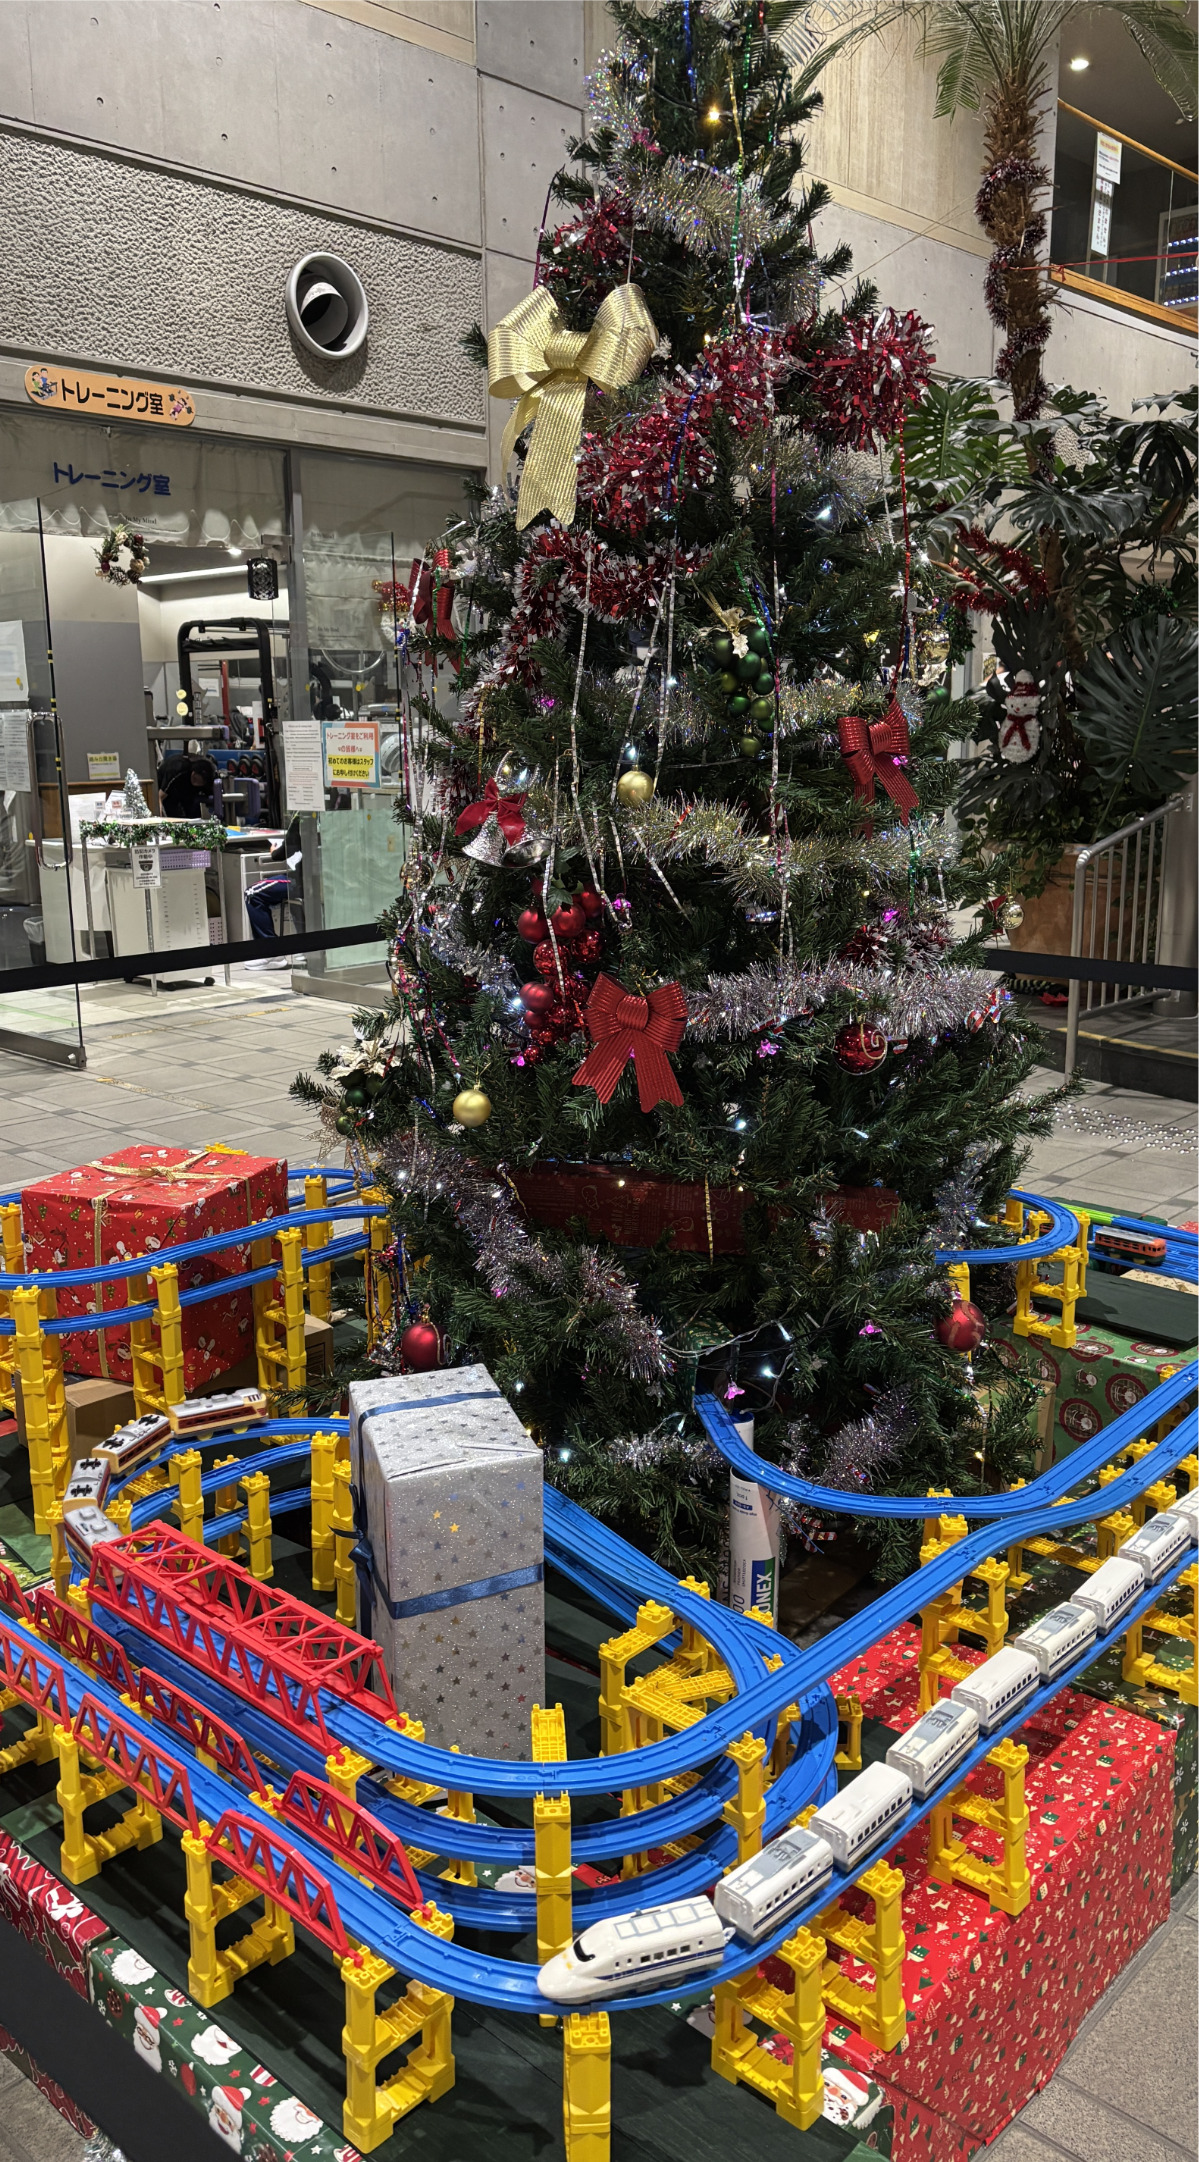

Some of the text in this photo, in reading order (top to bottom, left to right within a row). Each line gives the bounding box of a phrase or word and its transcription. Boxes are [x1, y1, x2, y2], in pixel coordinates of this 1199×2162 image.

[61, 379, 164, 416] トレーニング室
[53, 462, 171, 496] トレーニング室
[732, 1594, 745, 1613] 00
[755, 1571, 773, 1612] ONEX
